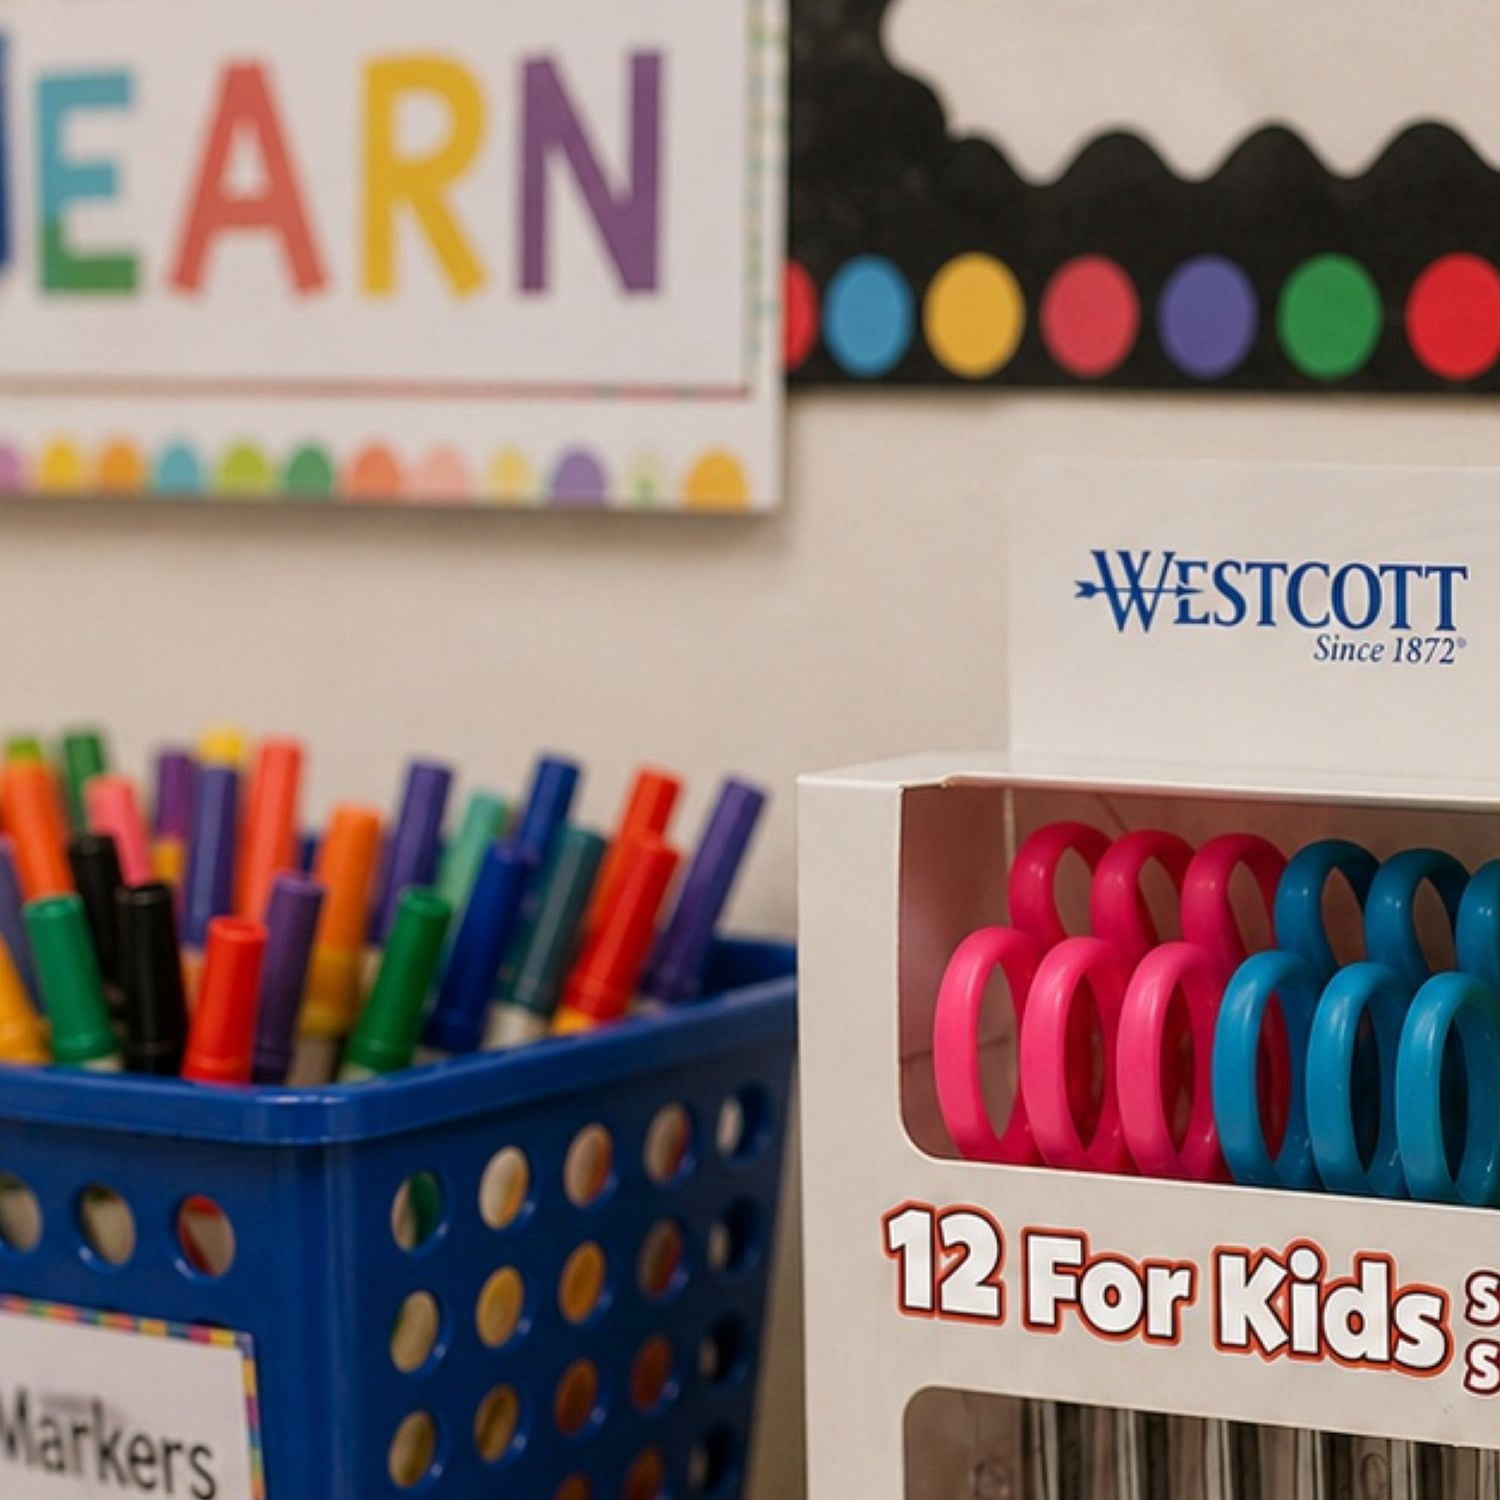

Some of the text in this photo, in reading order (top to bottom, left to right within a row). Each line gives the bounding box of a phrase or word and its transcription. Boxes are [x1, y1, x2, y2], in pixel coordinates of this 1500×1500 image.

[0, 28, 664, 302] EARN
[1074, 549, 1469, 633] WESTCOTT
[1314, 633, 1385, 664] Since
[882, 1200, 1452, 1378] 12 For Kids
